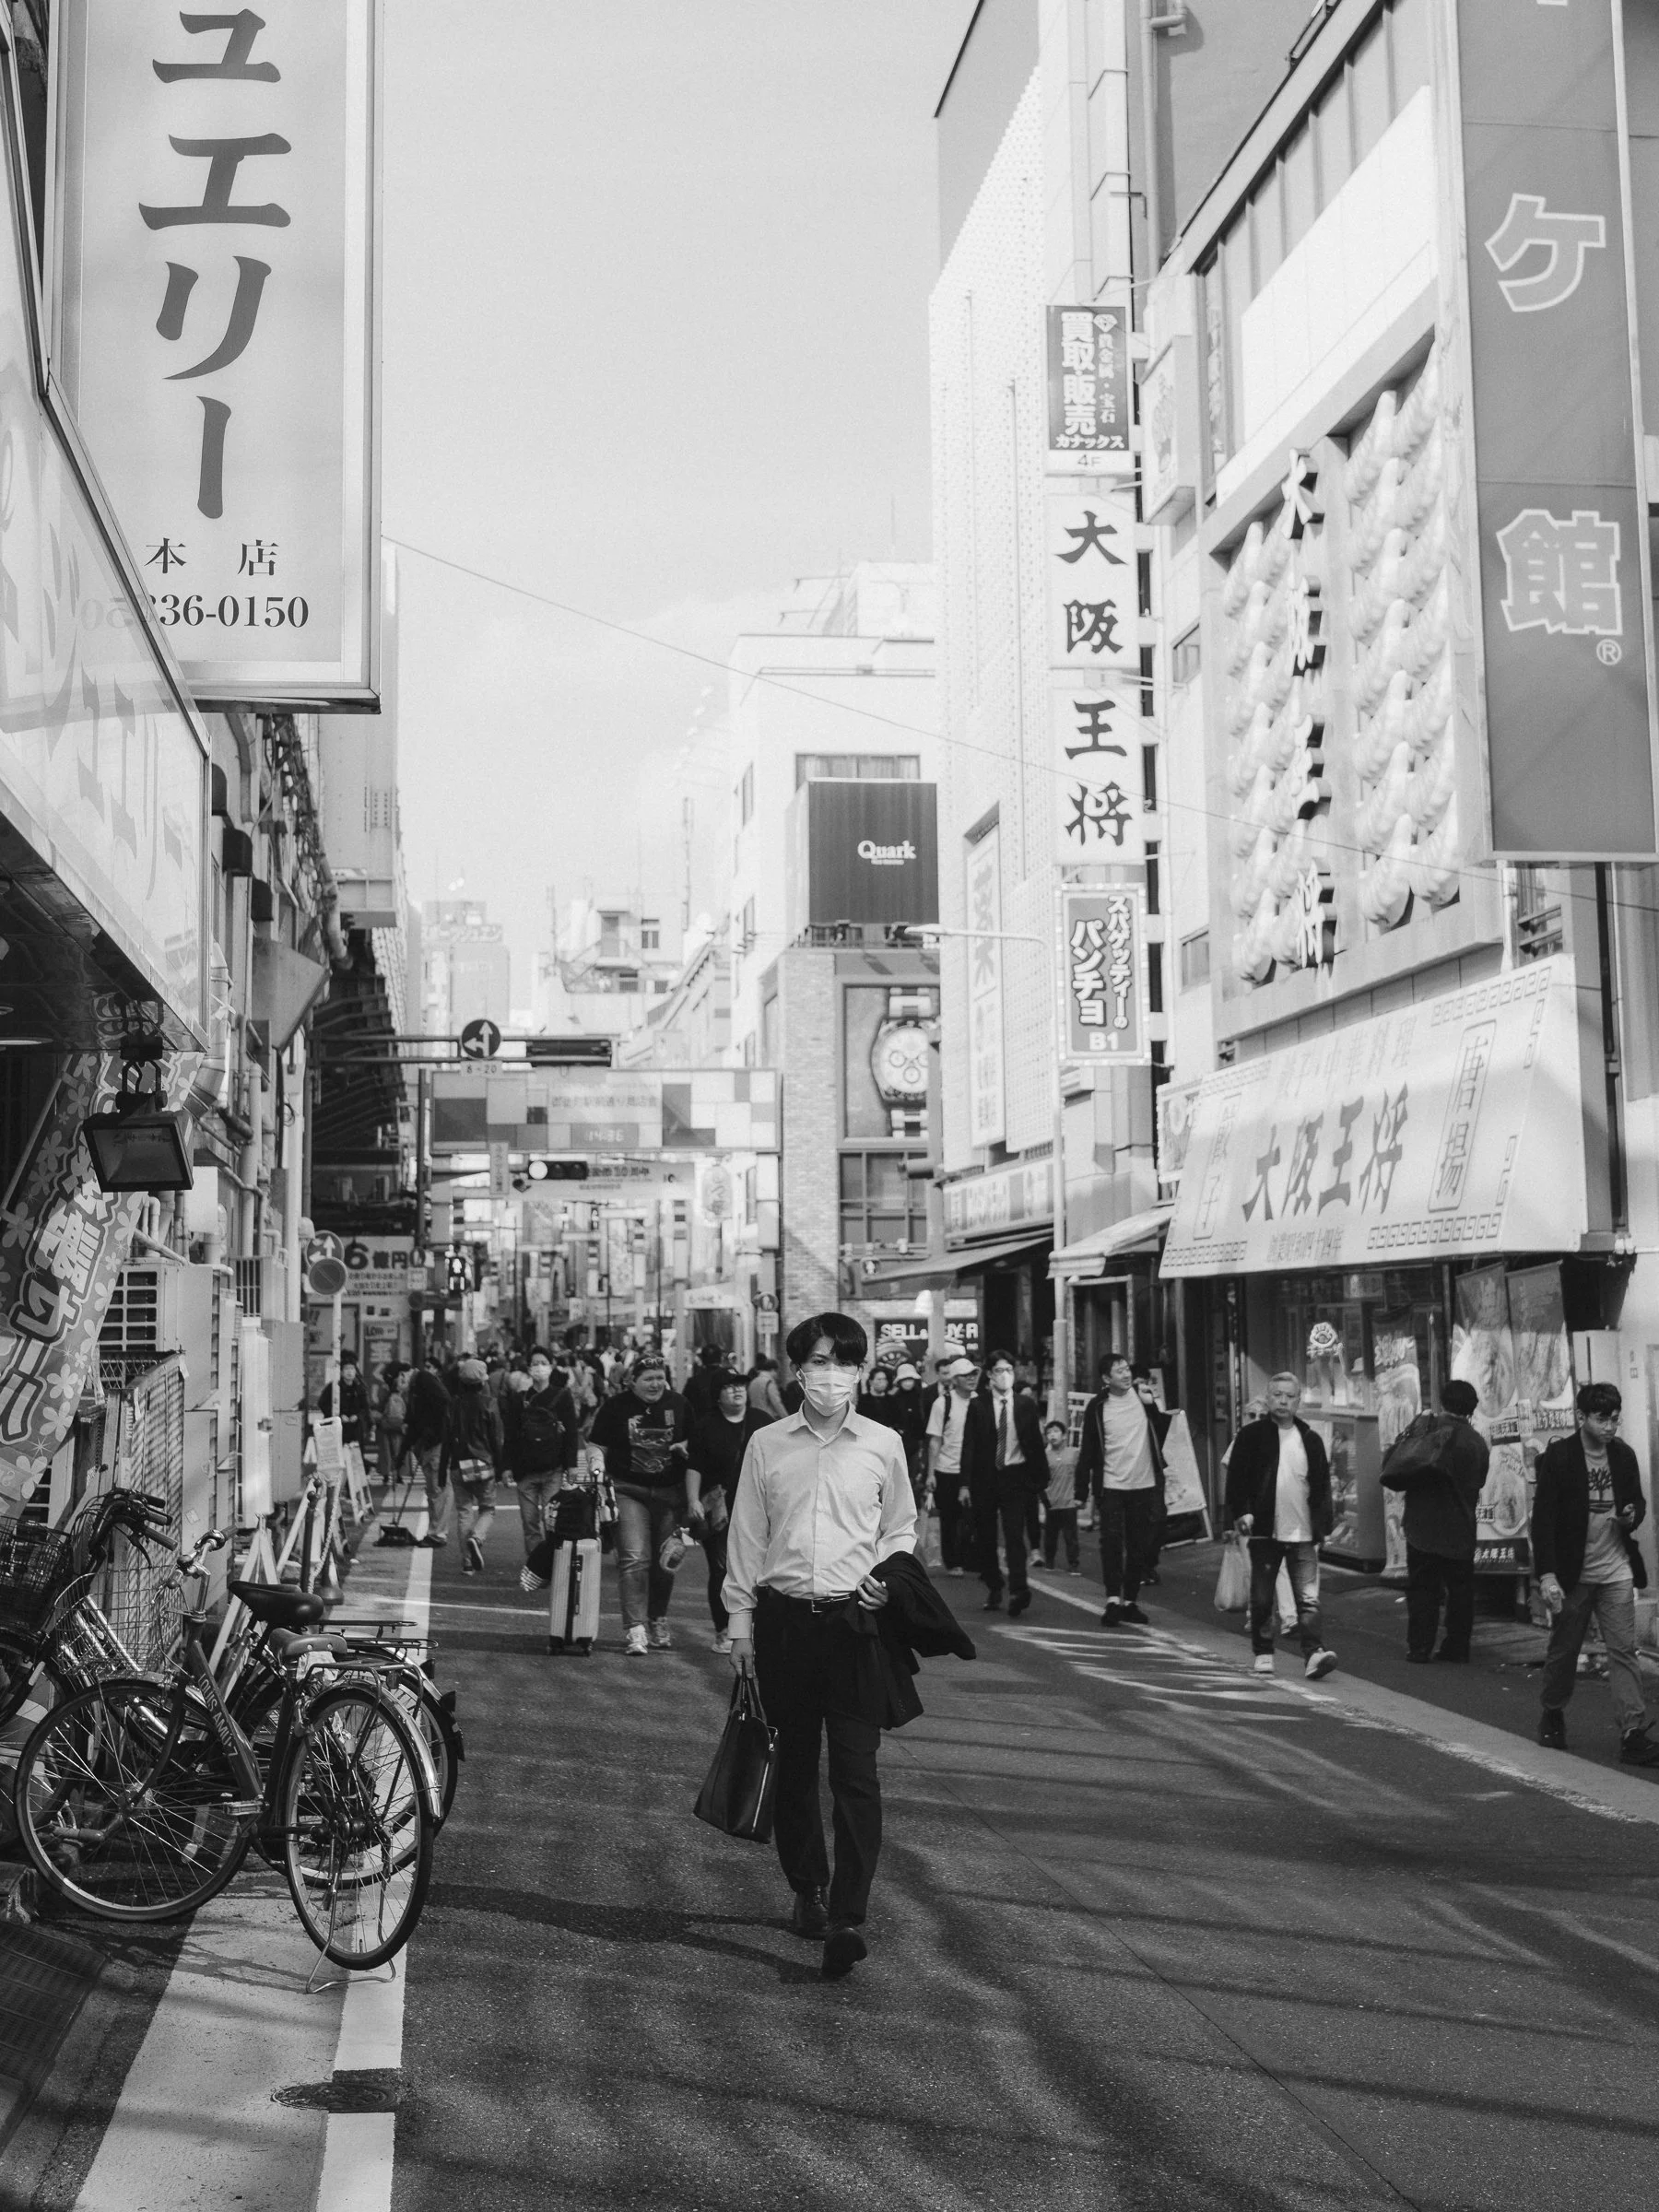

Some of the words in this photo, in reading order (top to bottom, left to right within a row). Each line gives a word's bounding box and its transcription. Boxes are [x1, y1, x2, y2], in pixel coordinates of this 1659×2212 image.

[1485, 0, 1623, 636] ケ館
[1055, 433, 1125, 450] カナックス
[148, 594, 310, 629] 36-0150
[1054, 510, 1133, 847] 大阪王将
[857, 840, 917, 860] Quark
[1107, 895, 1132, 1030] スパゲッティーの
[1088, 1031, 1119, 1052] B1
[1243, 1082, 1408, 1222] 大阪王将
[1436, 1036, 1489, 1198] 唐揚
[198, 1673, 218, 1712] LOUIS
